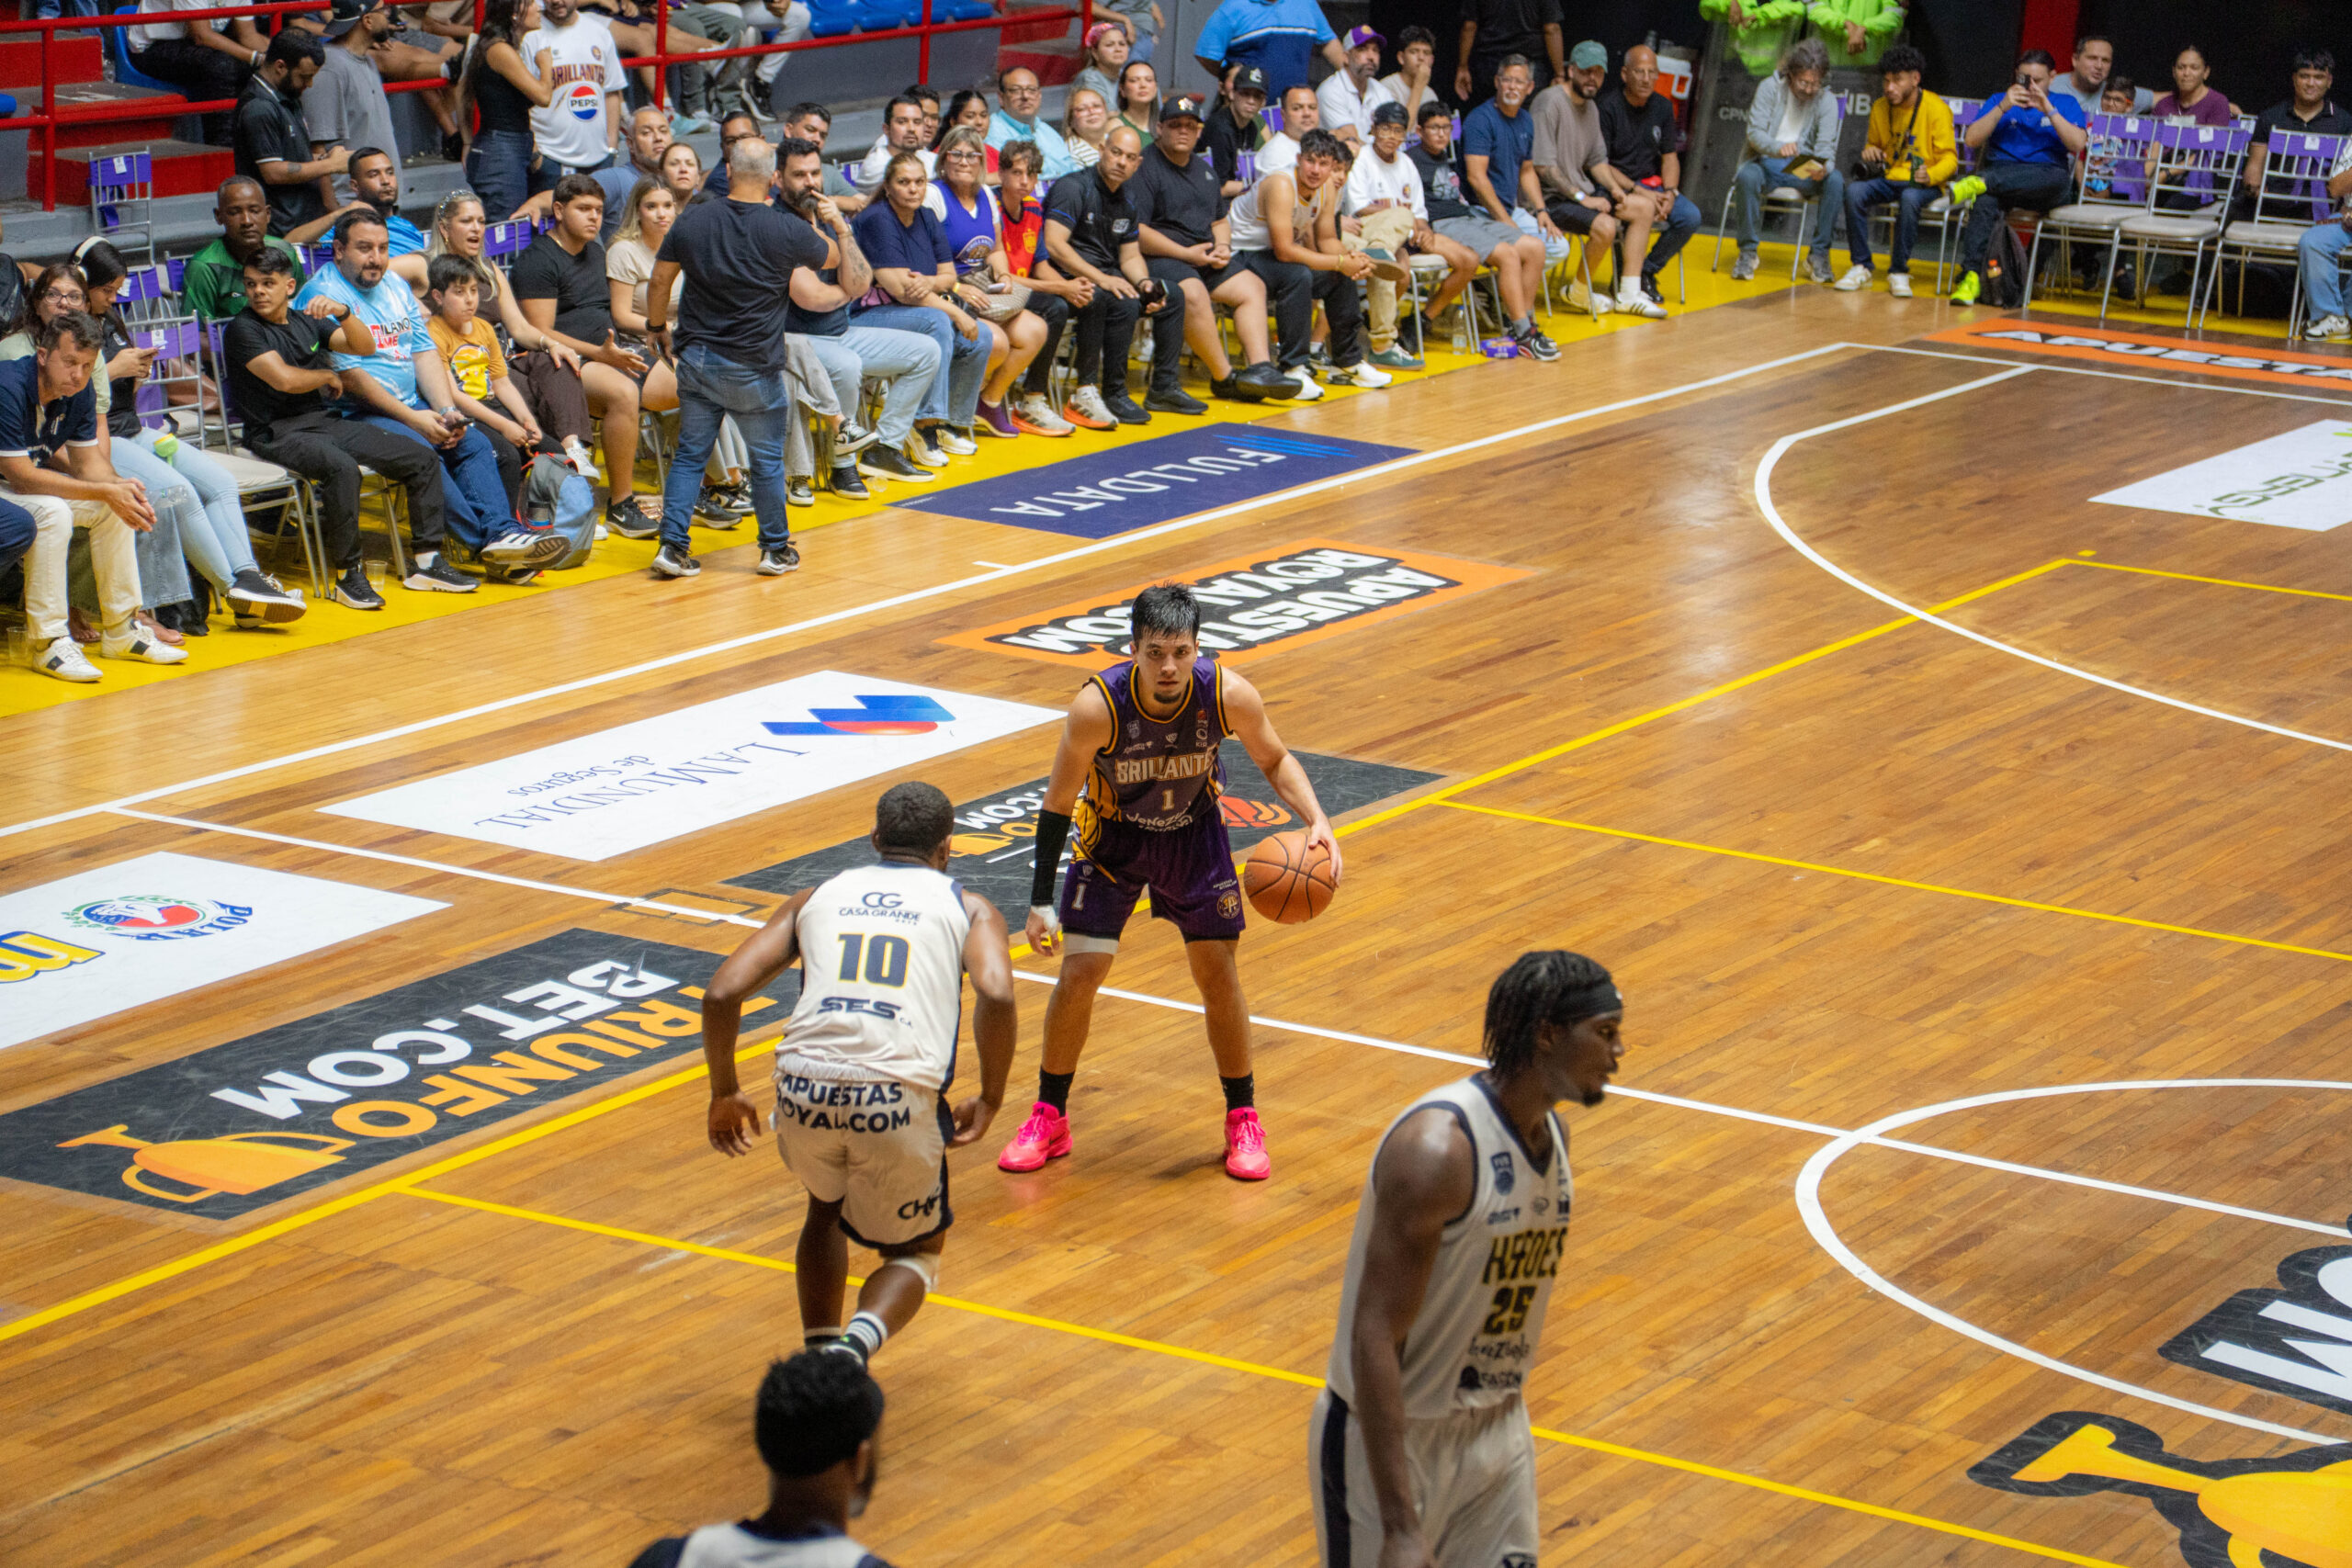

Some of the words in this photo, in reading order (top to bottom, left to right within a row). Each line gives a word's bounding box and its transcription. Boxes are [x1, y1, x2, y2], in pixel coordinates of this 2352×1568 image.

[989, 447, 1285, 517] FULLDATA
[613, 754, 655, 776] de
[506, 764, 623, 796] Seguros
[1161, 789, 1175, 811] 1
[862, 891, 904, 908] CG
[1071, 883, 1087, 911] 1
[839, 908, 869, 917] CASA
[871, 908, 921, 921] GRANDE
[837, 931, 911, 989] 10
[816, 996, 903, 1021] SES
[1484, 1285, 1537, 1335] 25
